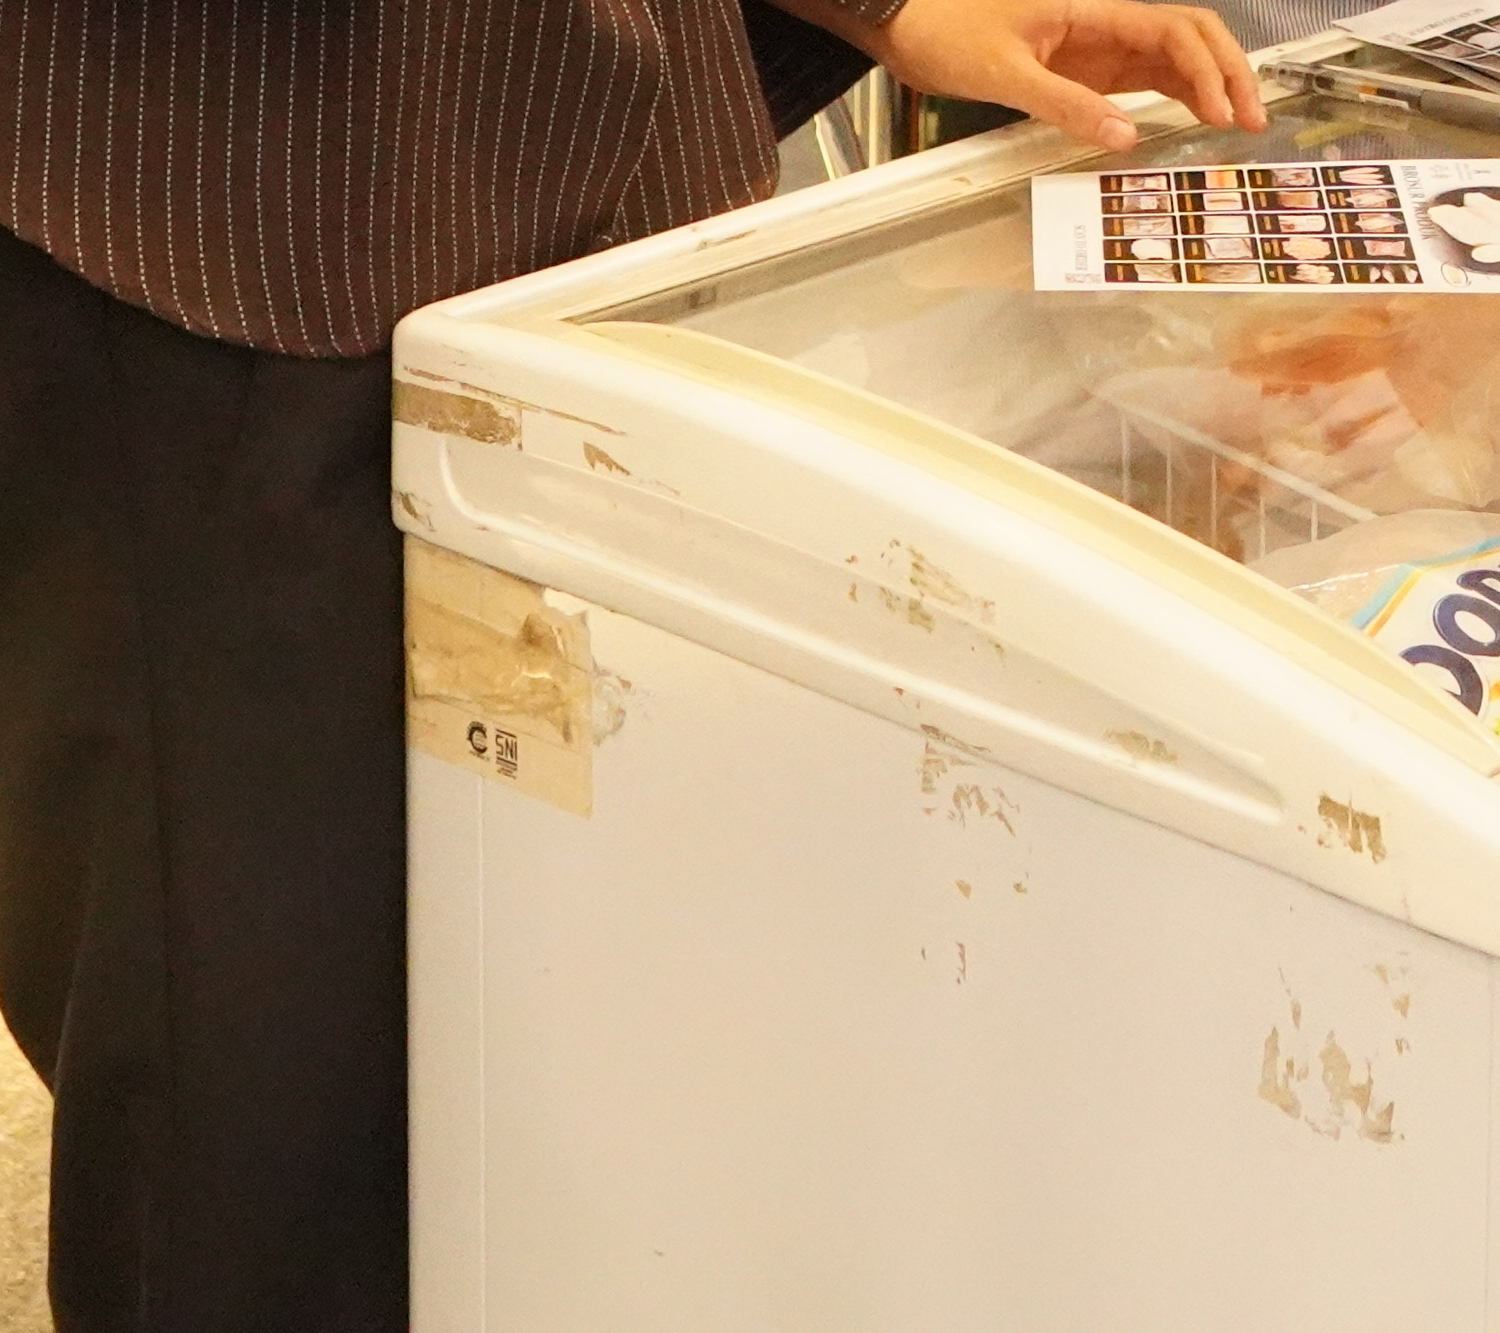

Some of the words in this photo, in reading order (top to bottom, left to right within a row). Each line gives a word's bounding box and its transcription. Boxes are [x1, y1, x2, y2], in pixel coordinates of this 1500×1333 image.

[1400, 165, 1426, 200] BROSUR
[1411, 201, 1438, 241] PRODUK
[495, 734, 518, 762] SNI
